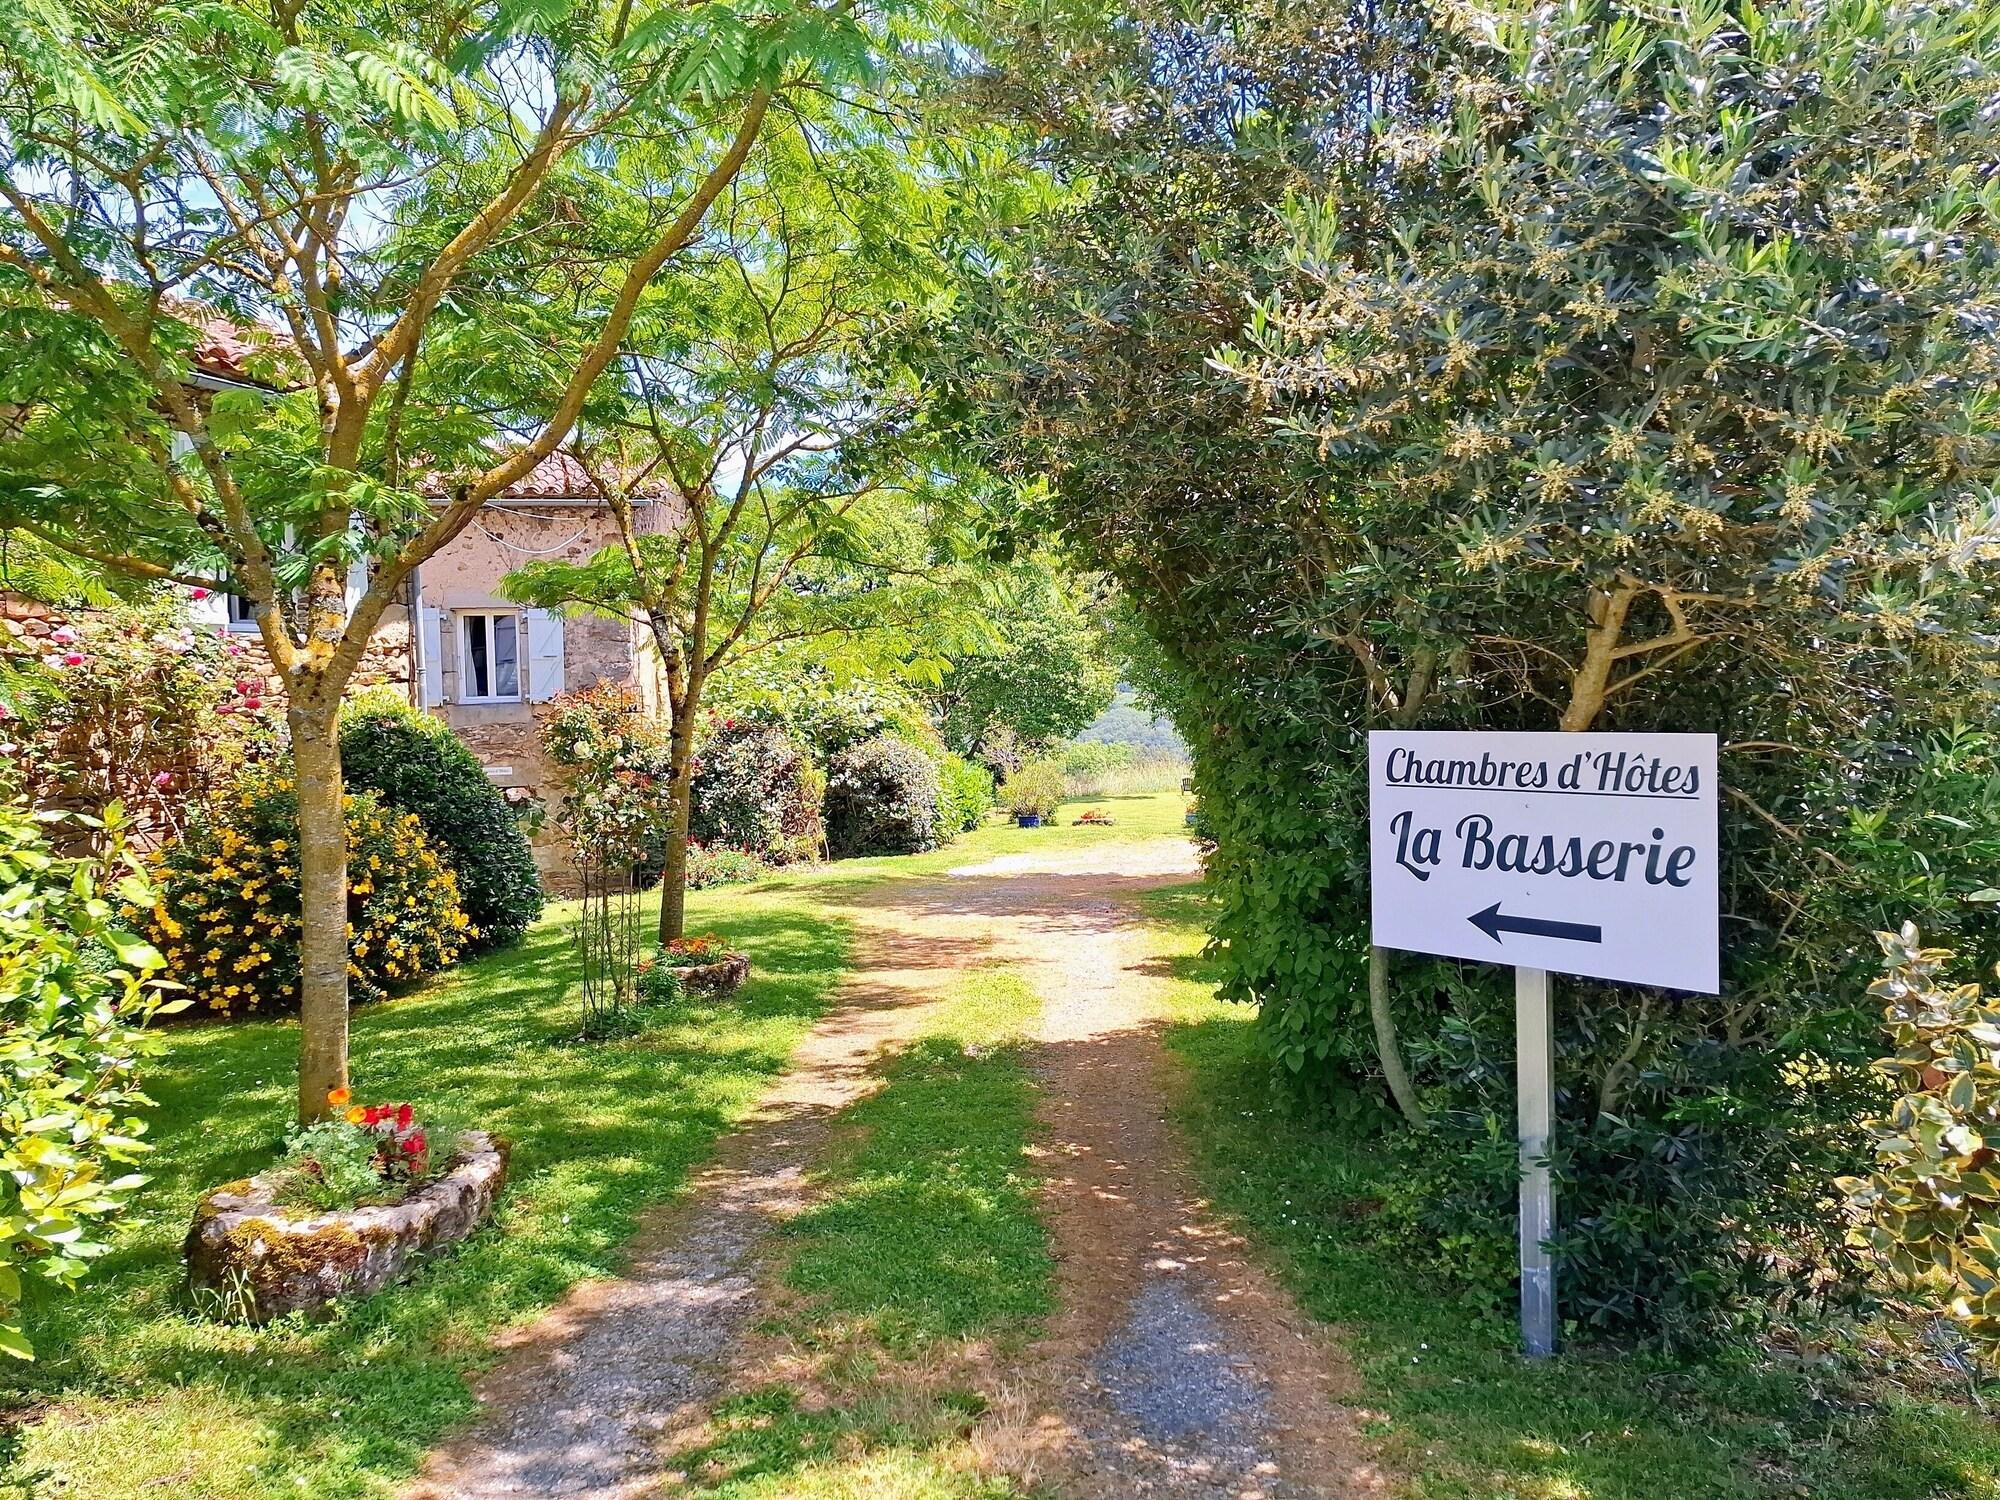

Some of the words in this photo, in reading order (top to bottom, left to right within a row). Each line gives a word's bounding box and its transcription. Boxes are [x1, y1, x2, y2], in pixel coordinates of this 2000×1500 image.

[1385, 747, 1548, 787] Chambres
[1558, 751, 1699, 794] d’Hôtes
[1390, 810, 1442, 881] La
[1455, 813, 1697, 887] Basserie
